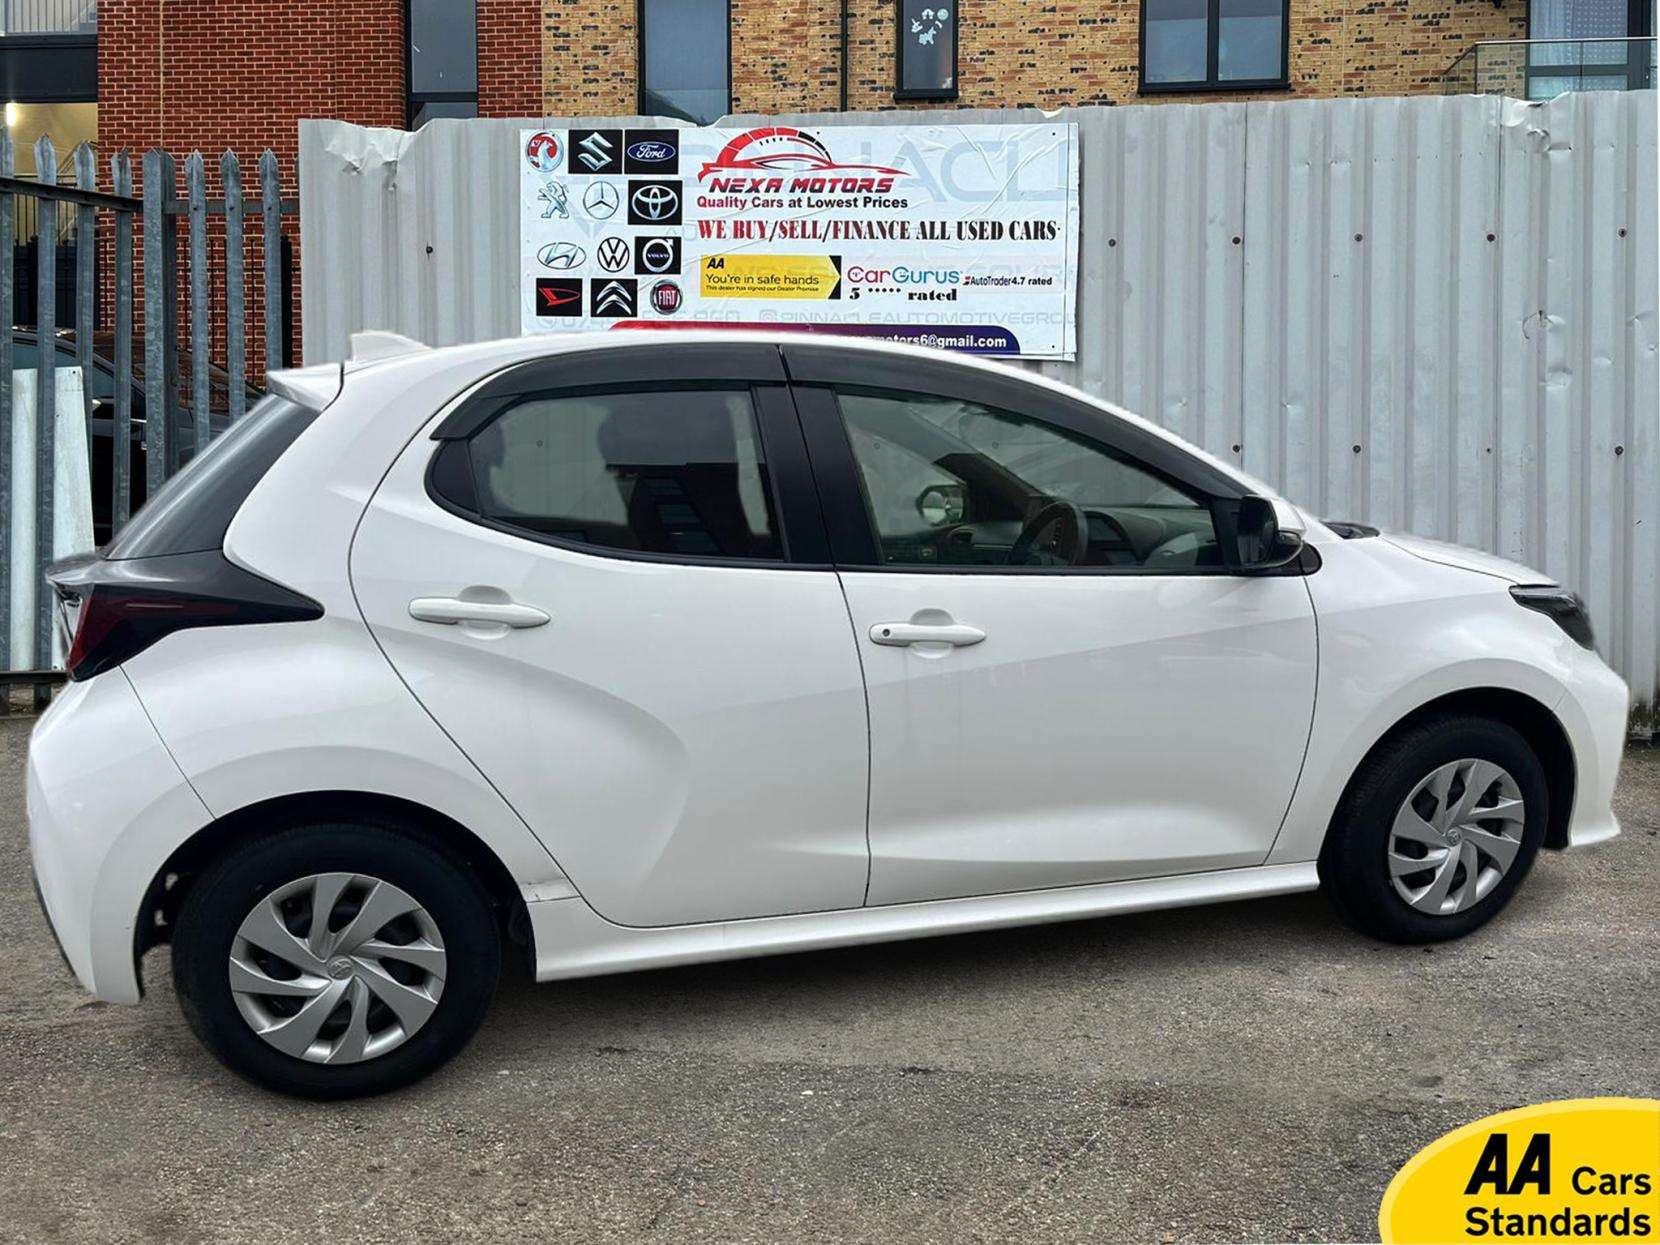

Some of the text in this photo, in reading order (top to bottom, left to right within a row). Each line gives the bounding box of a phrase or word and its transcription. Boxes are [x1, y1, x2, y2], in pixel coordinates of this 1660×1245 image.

[636, 144, 666, 158] Ford
[709, 178, 894, 193] NEXA MOTORS
[697, 196, 908, 210] Quality Cars at Lowest Prices
[698, 220, 727, 240] WE
[732, 220, 911, 242] BUY/SELL/FINANCE
[916, 221, 950, 240] ALL
[956, 221, 1004, 240] USED
[1009, 221, 1057, 240] CARS
[707, 258, 725, 269] AA
[705, 274, 820, 284] You're in safe hands
[847, 266, 961, 284] CarGurus
[1028, 277, 1052, 285] rated
[658, 290, 676, 305] FIAT
[849, 287, 957, 301] 5 rated
